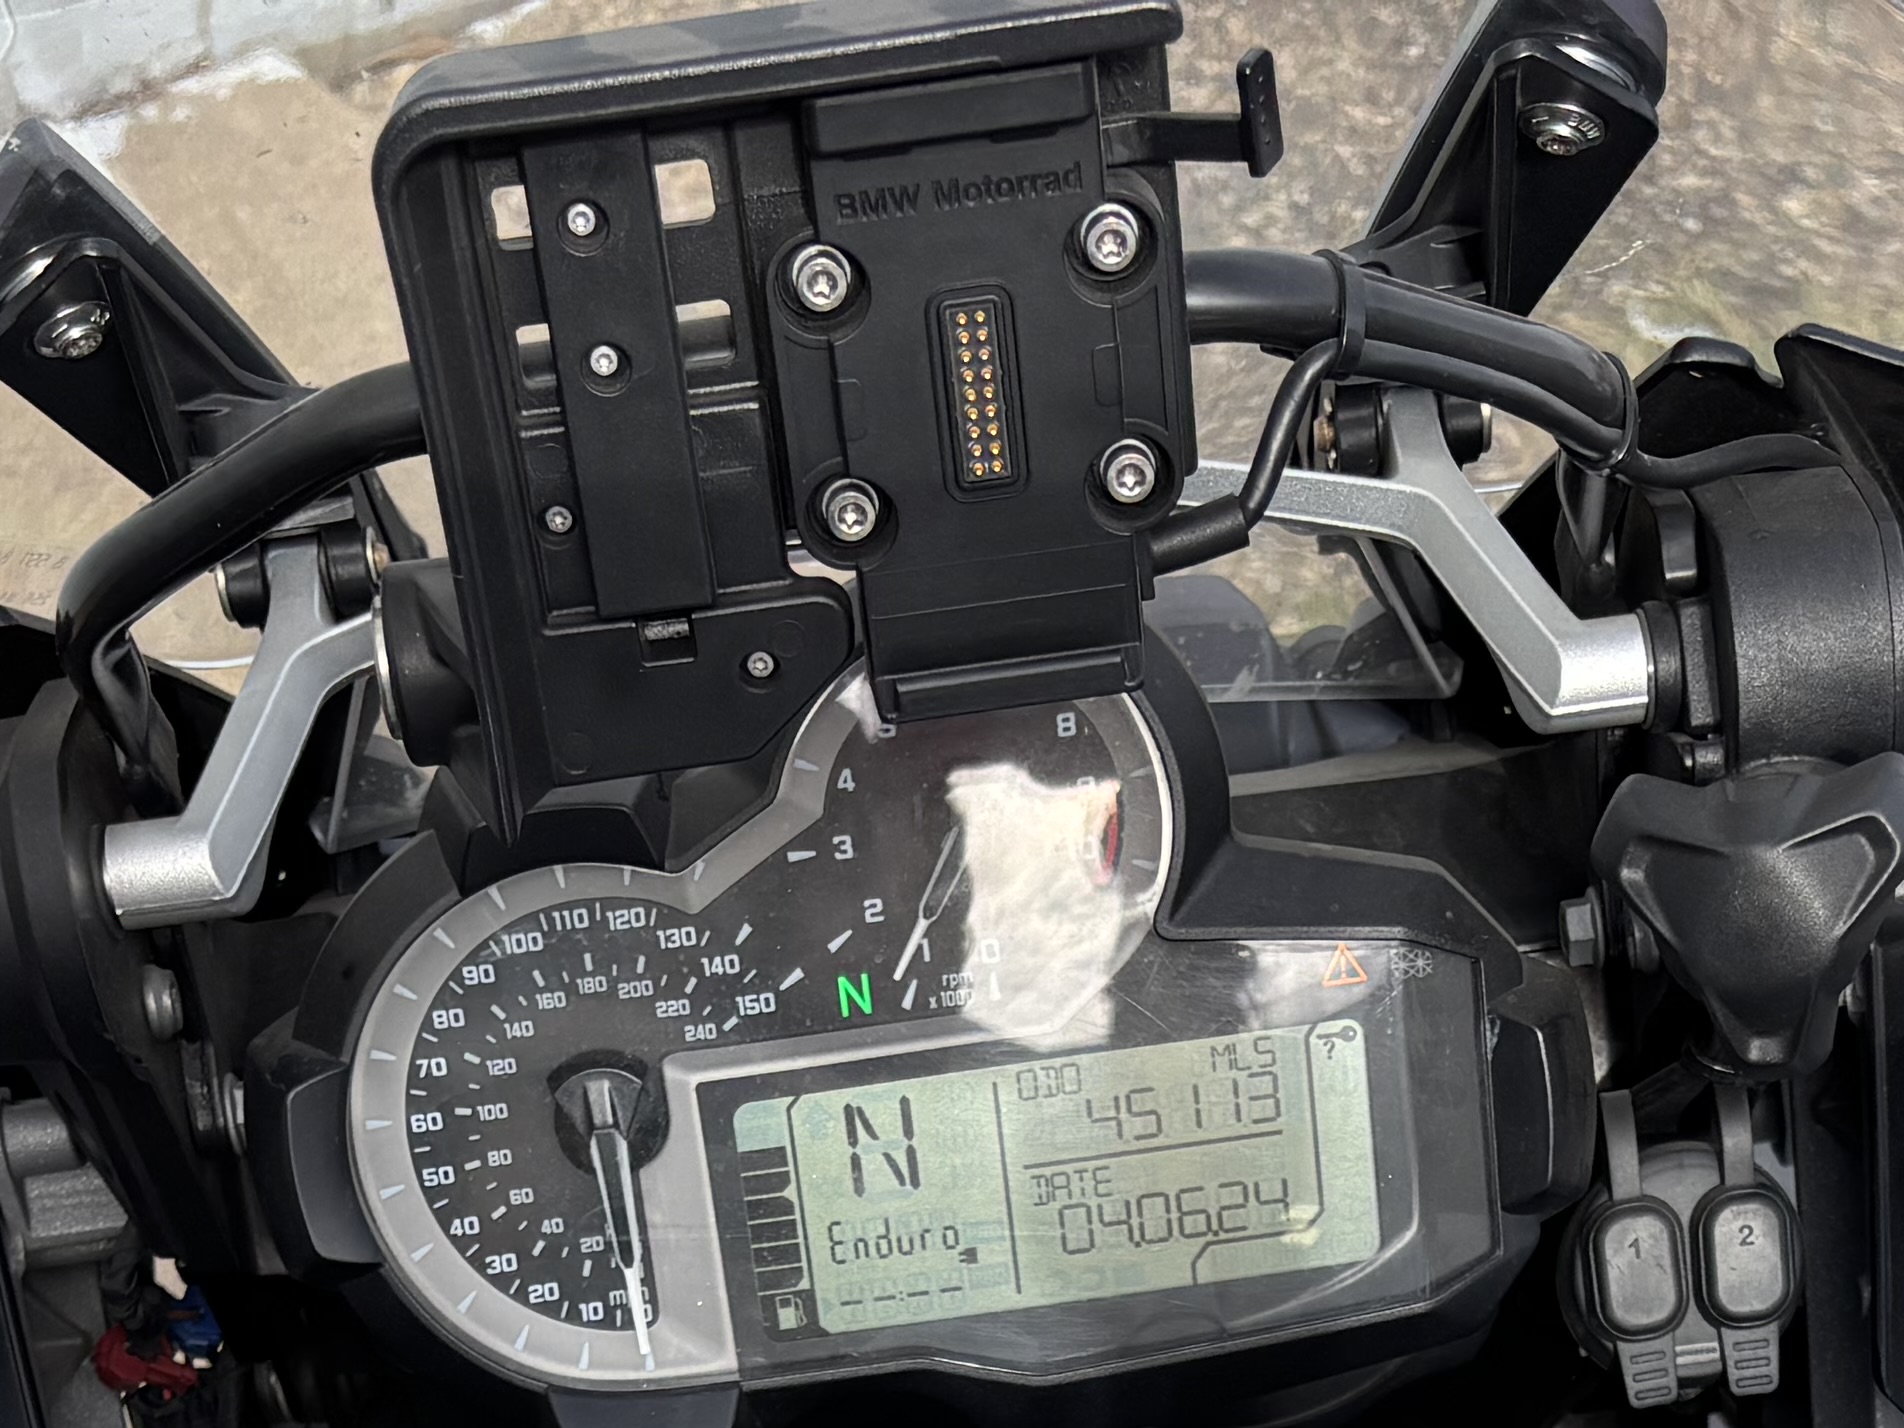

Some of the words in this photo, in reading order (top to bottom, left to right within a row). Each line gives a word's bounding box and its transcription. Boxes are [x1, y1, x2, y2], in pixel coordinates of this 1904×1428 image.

[833, 182, 921, 225] BMW
[931, 160, 1084, 211] Motorrad
[1056, 711, 1077, 738] 8
[837, 768, 856, 792] 4
[832, 834, 854, 860] 3
[551, 907, 590, 931] 110
[605, 906, 646, 931] 120
[863, 898, 885, 924] 2
[500, 931, 544, 955] 100
[656, 926, 697, 950] 130
[461, 963, 496, 986] 90
[700, 954, 741, 977] 140
[575, 975, 608, 995] 180
[617, 979, 654, 999] 200
[941, 970, 975, 987] rpm
[535, 991, 567, 1010] 160
[735, 992, 776, 1016] 150
[837, 972, 872, 1018] N
[432, 1008, 466, 1030] 80
[654, 998, 691, 1018] 220
[503, 1020, 535, 1040] 140
[683, 1023, 717, 1042] 240
[1210, 1036, 1277, 1073] MLS
[415, 1056, 448, 1078] 70
[485, 1057, 517, 1076] 120
[1016, 1062, 1082, 1101] ODO
[476, 1102, 509, 1121] 100
[1085, 1069, 1282, 1141] 45113
[410, 1111, 444, 1133] 60
[843, 1094, 921, 1198] N
[487, 1149, 513, 1167] 80
[421, 1165, 456, 1187] 50
[1031, 1164, 1112, 1207] DATE
[509, 1187, 534, 1205] 60
[449, 1215, 480, 1237] 40
[540, 1217, 565, 1235] 40
[1738, 1223, 1756, 1248] 2
[579, 1235, 605, 1253] 20
[827, 1216, 961, 1265] Enduro
[1627, 1236, 1642, 1260] 1
[485, 1253, 518, 1275] 30
[527, 1282, 560, 1304] 20
[578, 1301, 604, 1322] 10
